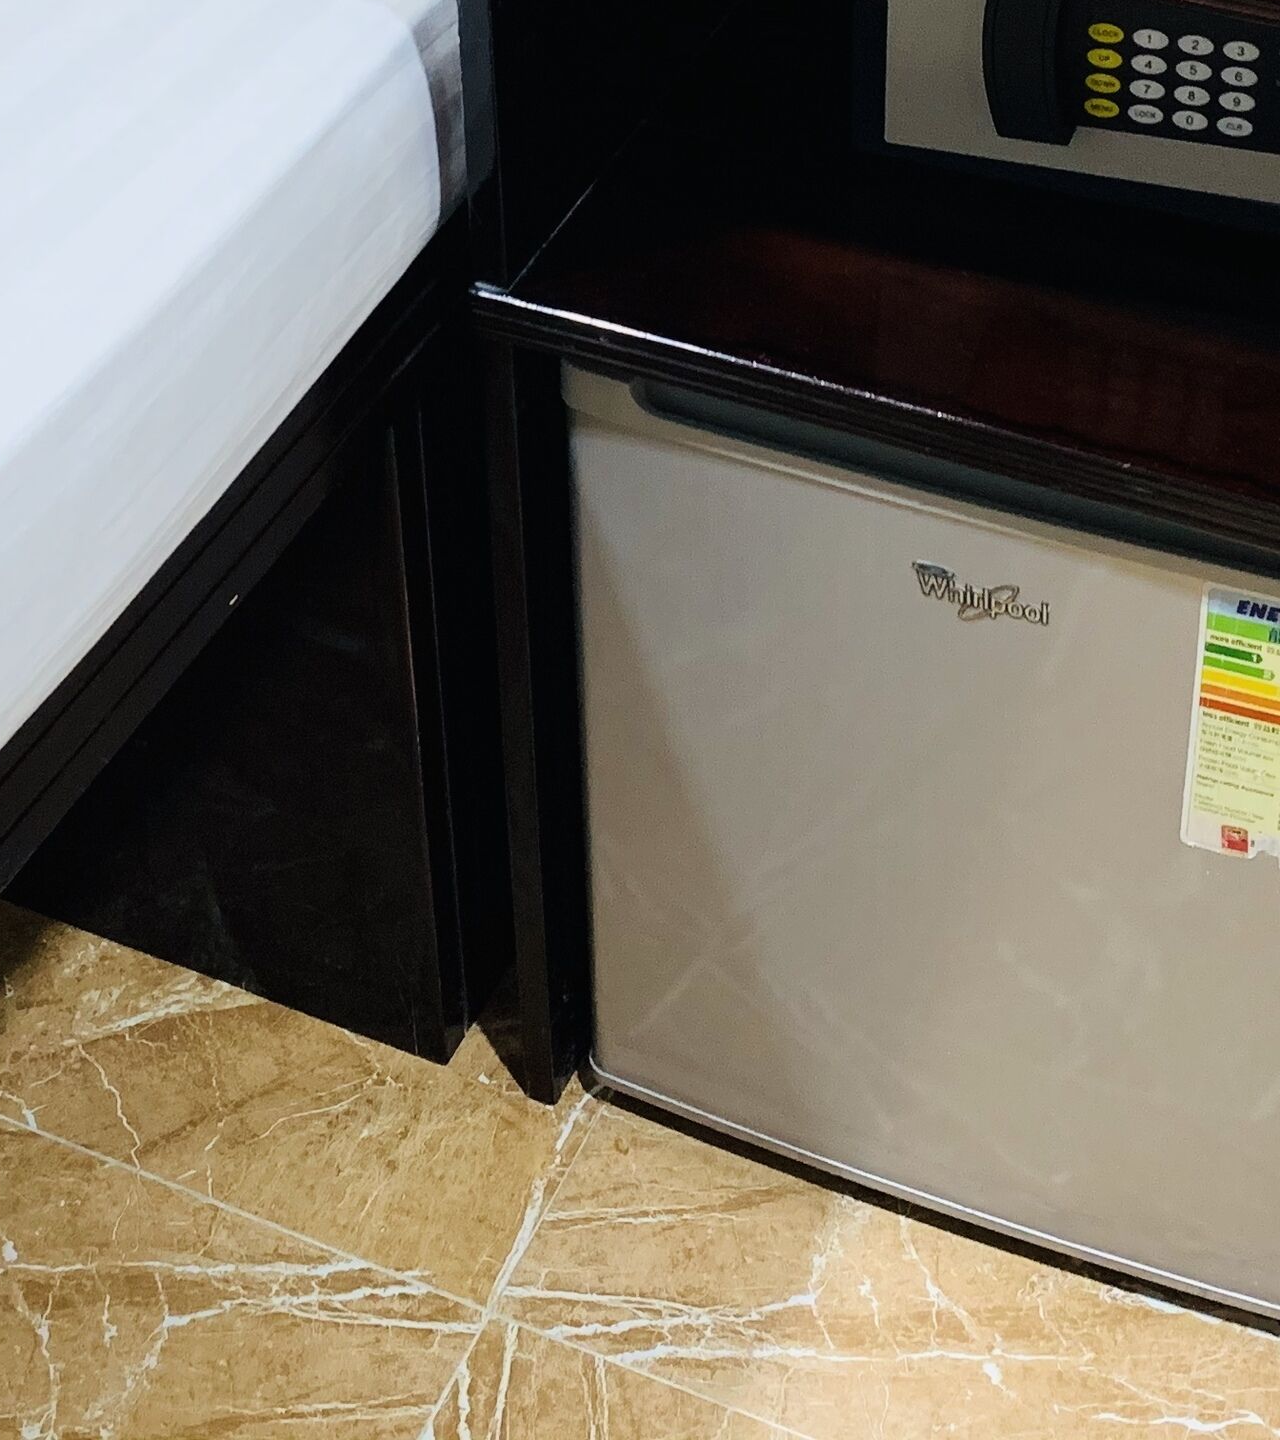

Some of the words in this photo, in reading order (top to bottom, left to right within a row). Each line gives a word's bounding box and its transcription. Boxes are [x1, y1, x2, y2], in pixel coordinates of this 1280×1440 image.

[1191, 40, 1199, 51] 2
[1237, 46, 1245, 57] 3
[1144, 60, 1152, 69] 4
[1189, 65, 1198, 76] 5
[1234, 71, 1243, 82] 6
[1143, 84, 1151, 94] 7
[1188, 91, 1196, 101] 8
[1233, 96, 1241, 107] 9
[1134, 111, 1157, 120] LOCK
[1186, 115, 1194, 126] 0
[1226, 122, 1243, 131] CLR
[912, 563, 1050, 626] Whirlpool
